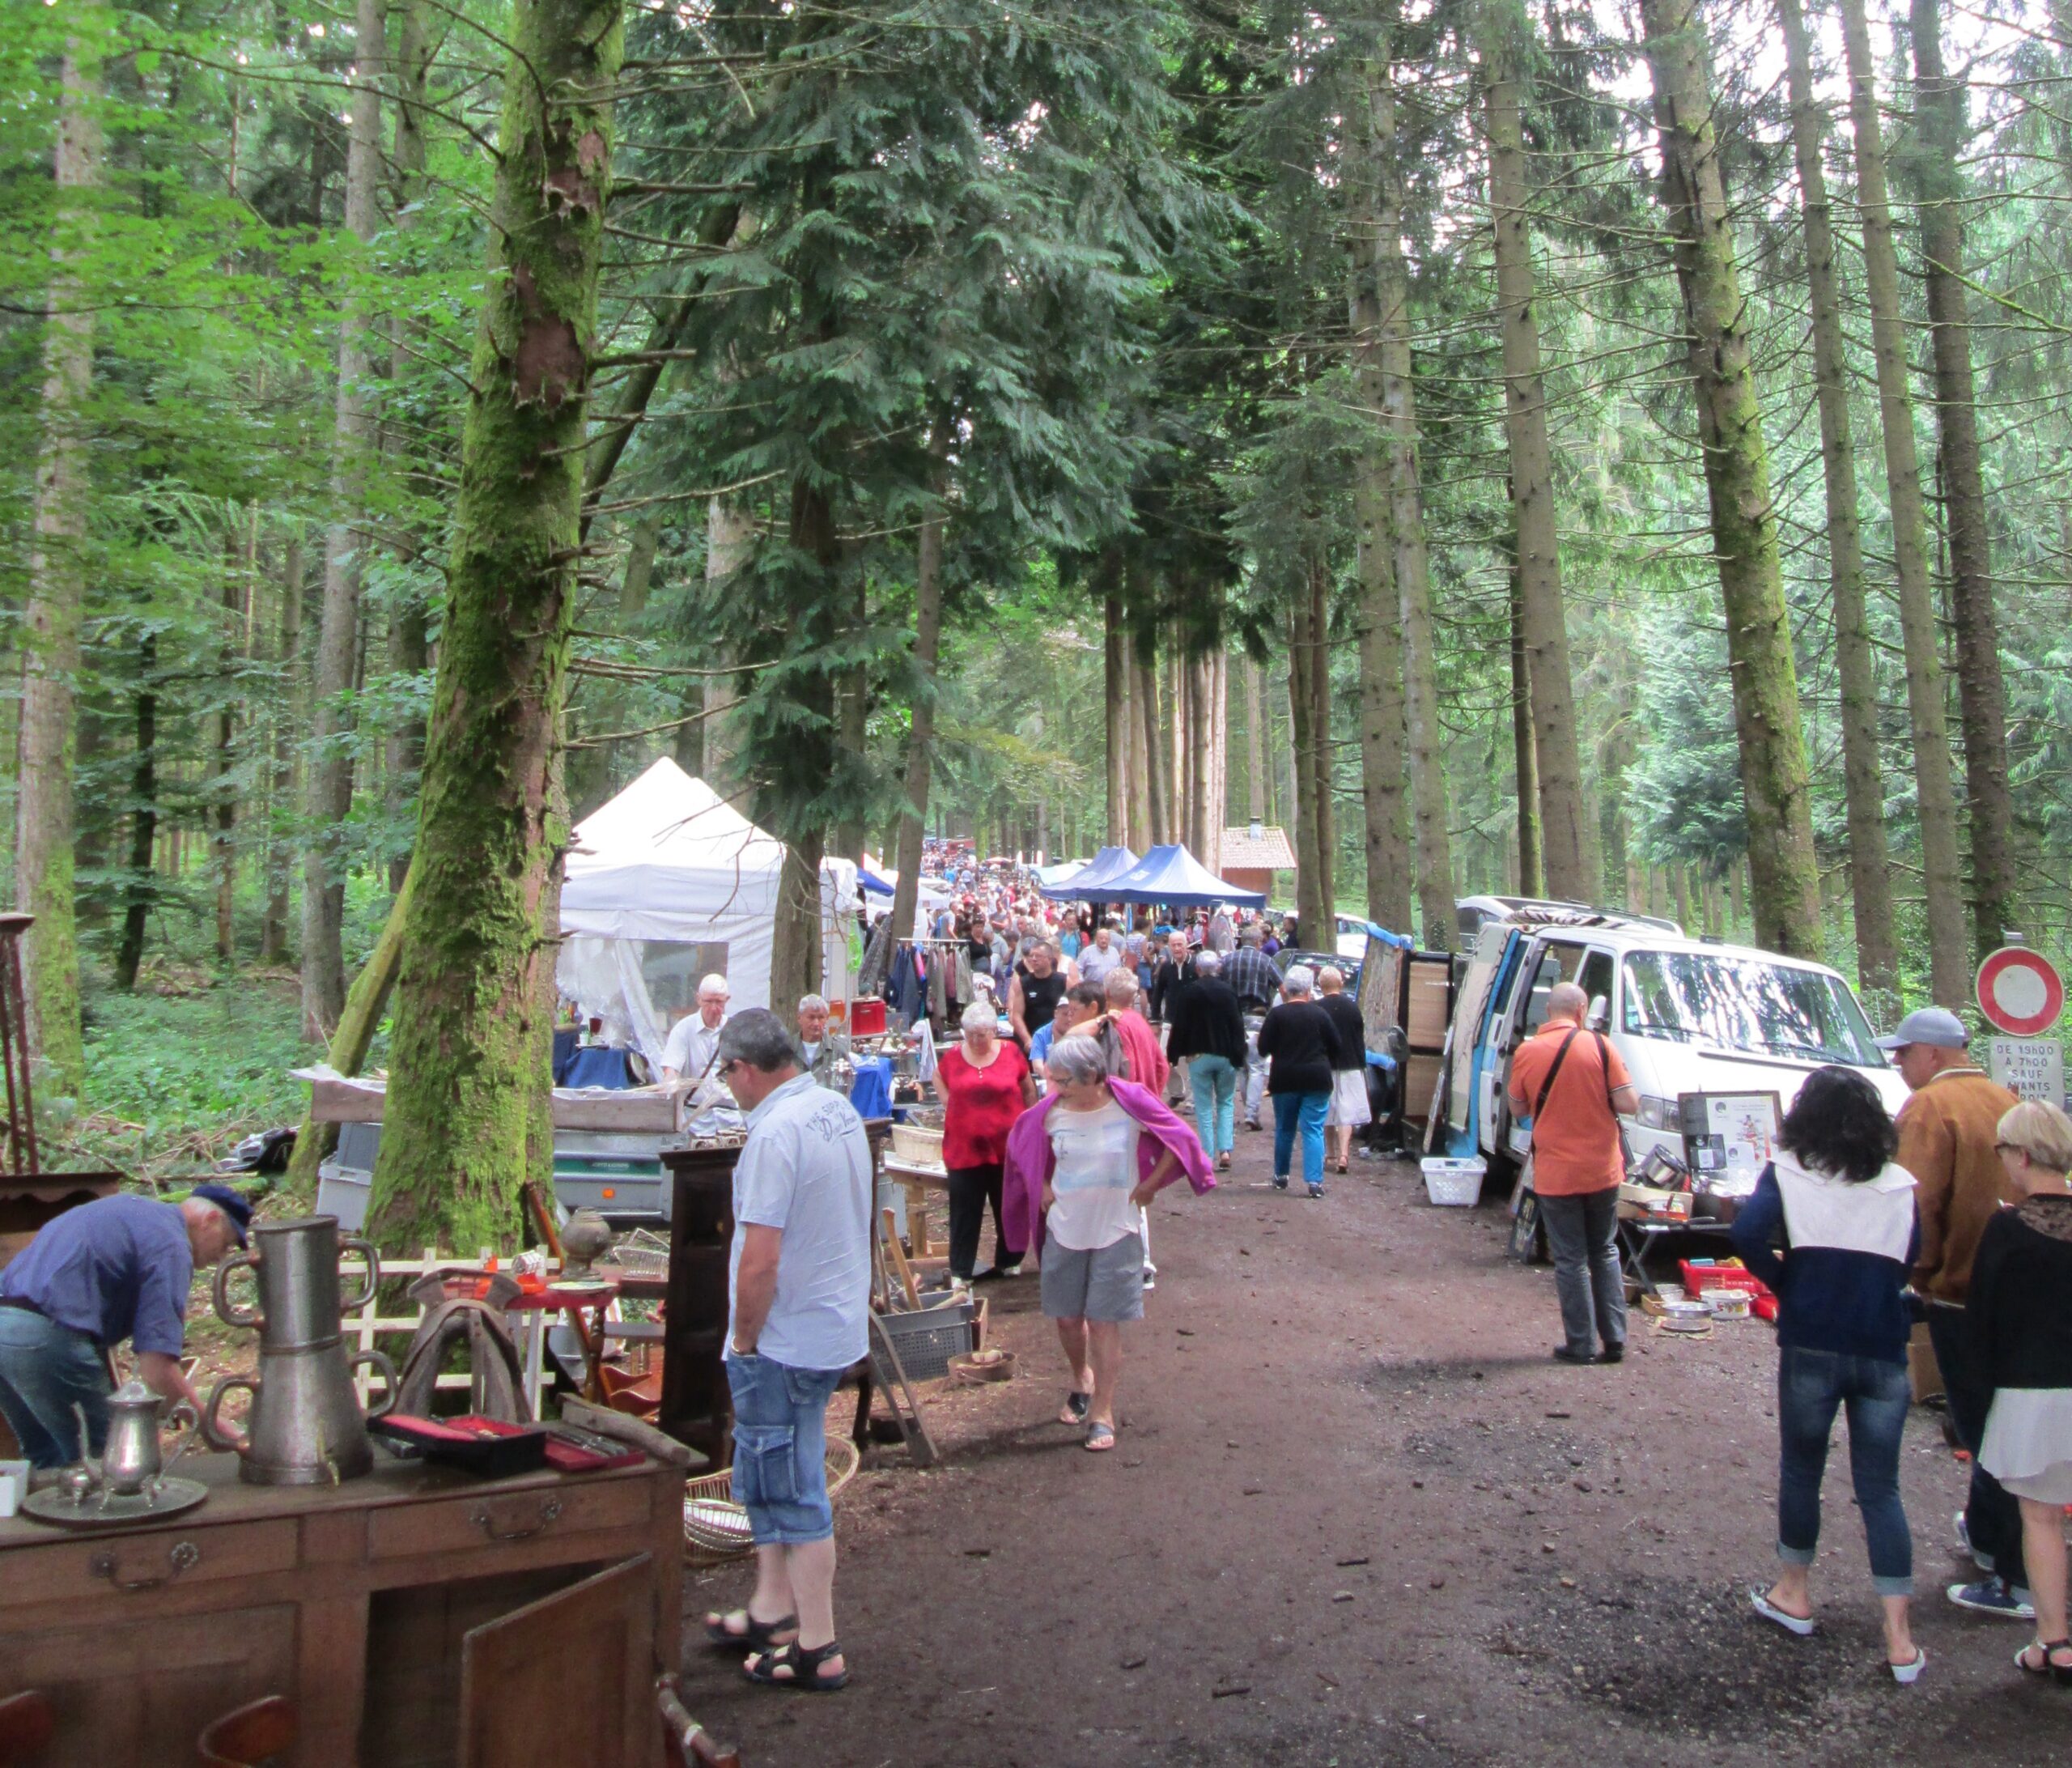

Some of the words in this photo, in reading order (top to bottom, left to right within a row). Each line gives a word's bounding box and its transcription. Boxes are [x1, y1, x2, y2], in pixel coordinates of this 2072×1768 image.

[1997, 1044, 2011, 1054] DE
[2019, 1045, 2053, 1055] 19h00
[2019, 1057, 2048, 1067] 7h00
[2011, 1069, 2044, 1079] SAUF
